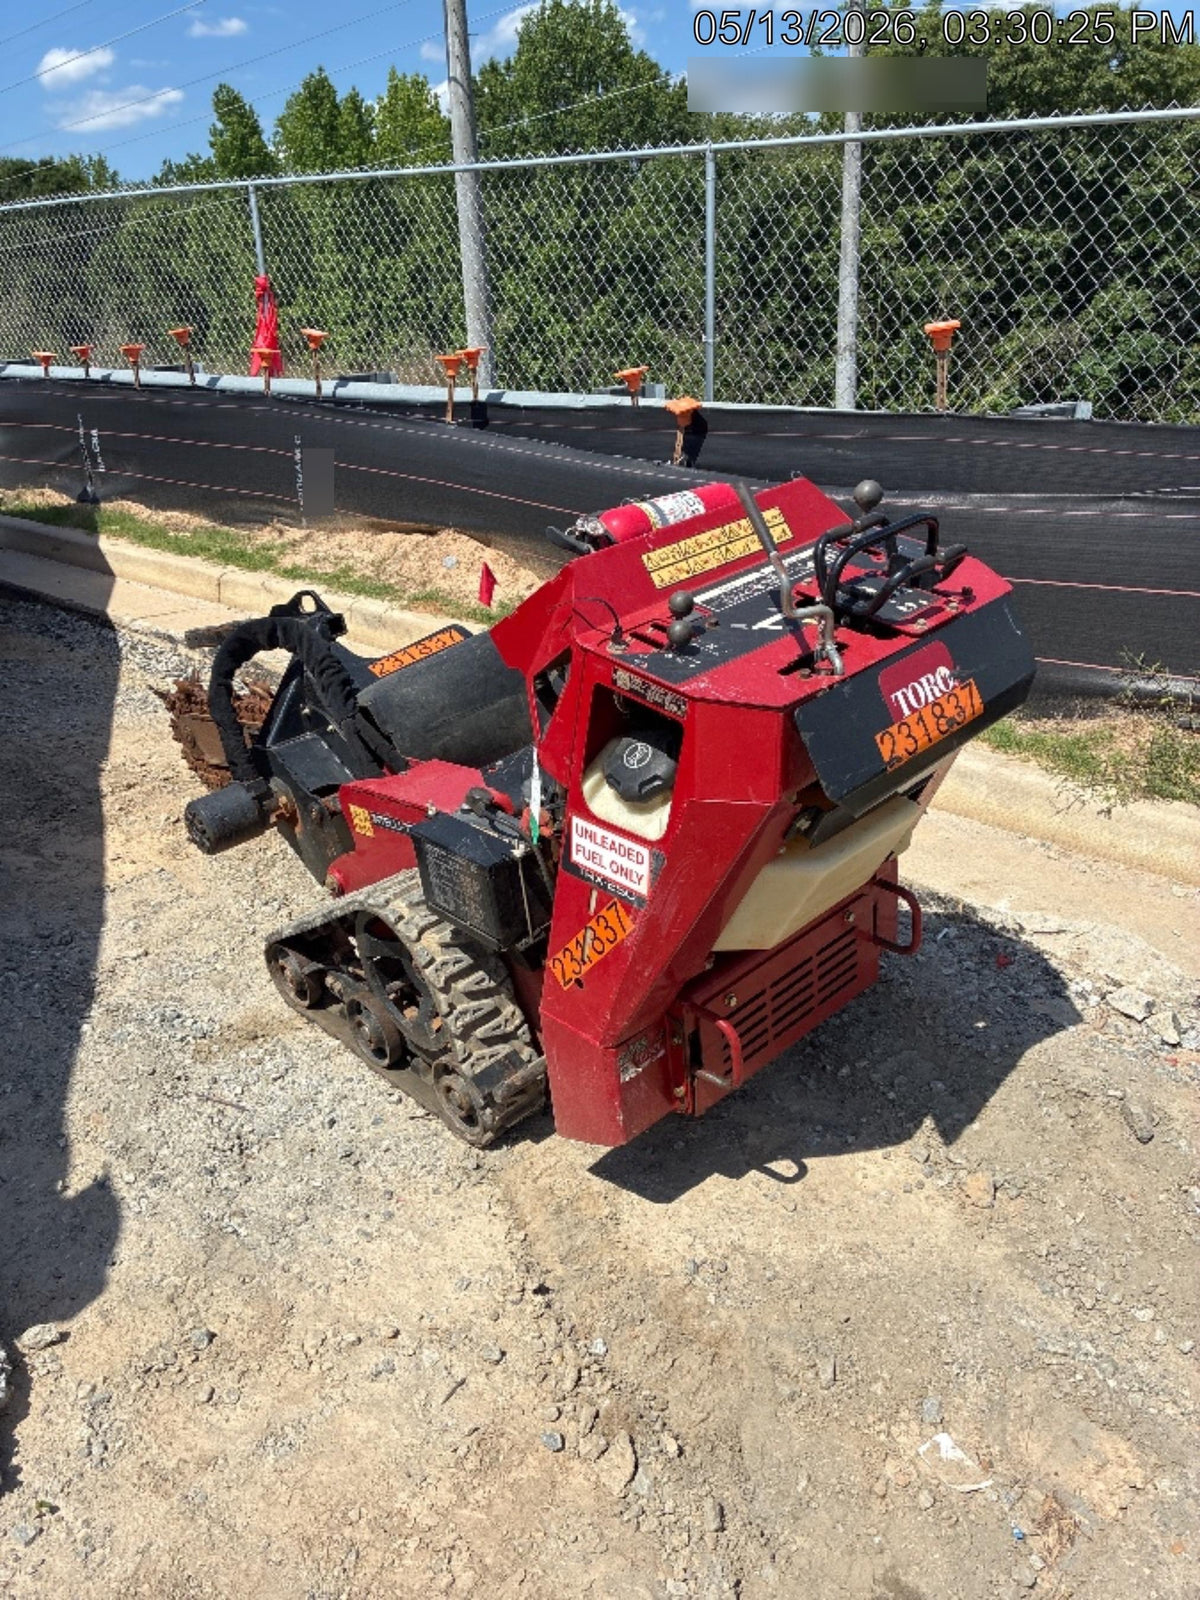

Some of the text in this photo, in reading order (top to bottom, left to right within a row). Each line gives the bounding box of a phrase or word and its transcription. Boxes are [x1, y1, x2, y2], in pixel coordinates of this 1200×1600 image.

[879, 679, 977, 769] 231837
[575, 822, 645, 866] UNLEADED
[575, 843, 645, 887] FUEL ONLY
[551, 900, 627, 988] 231837
